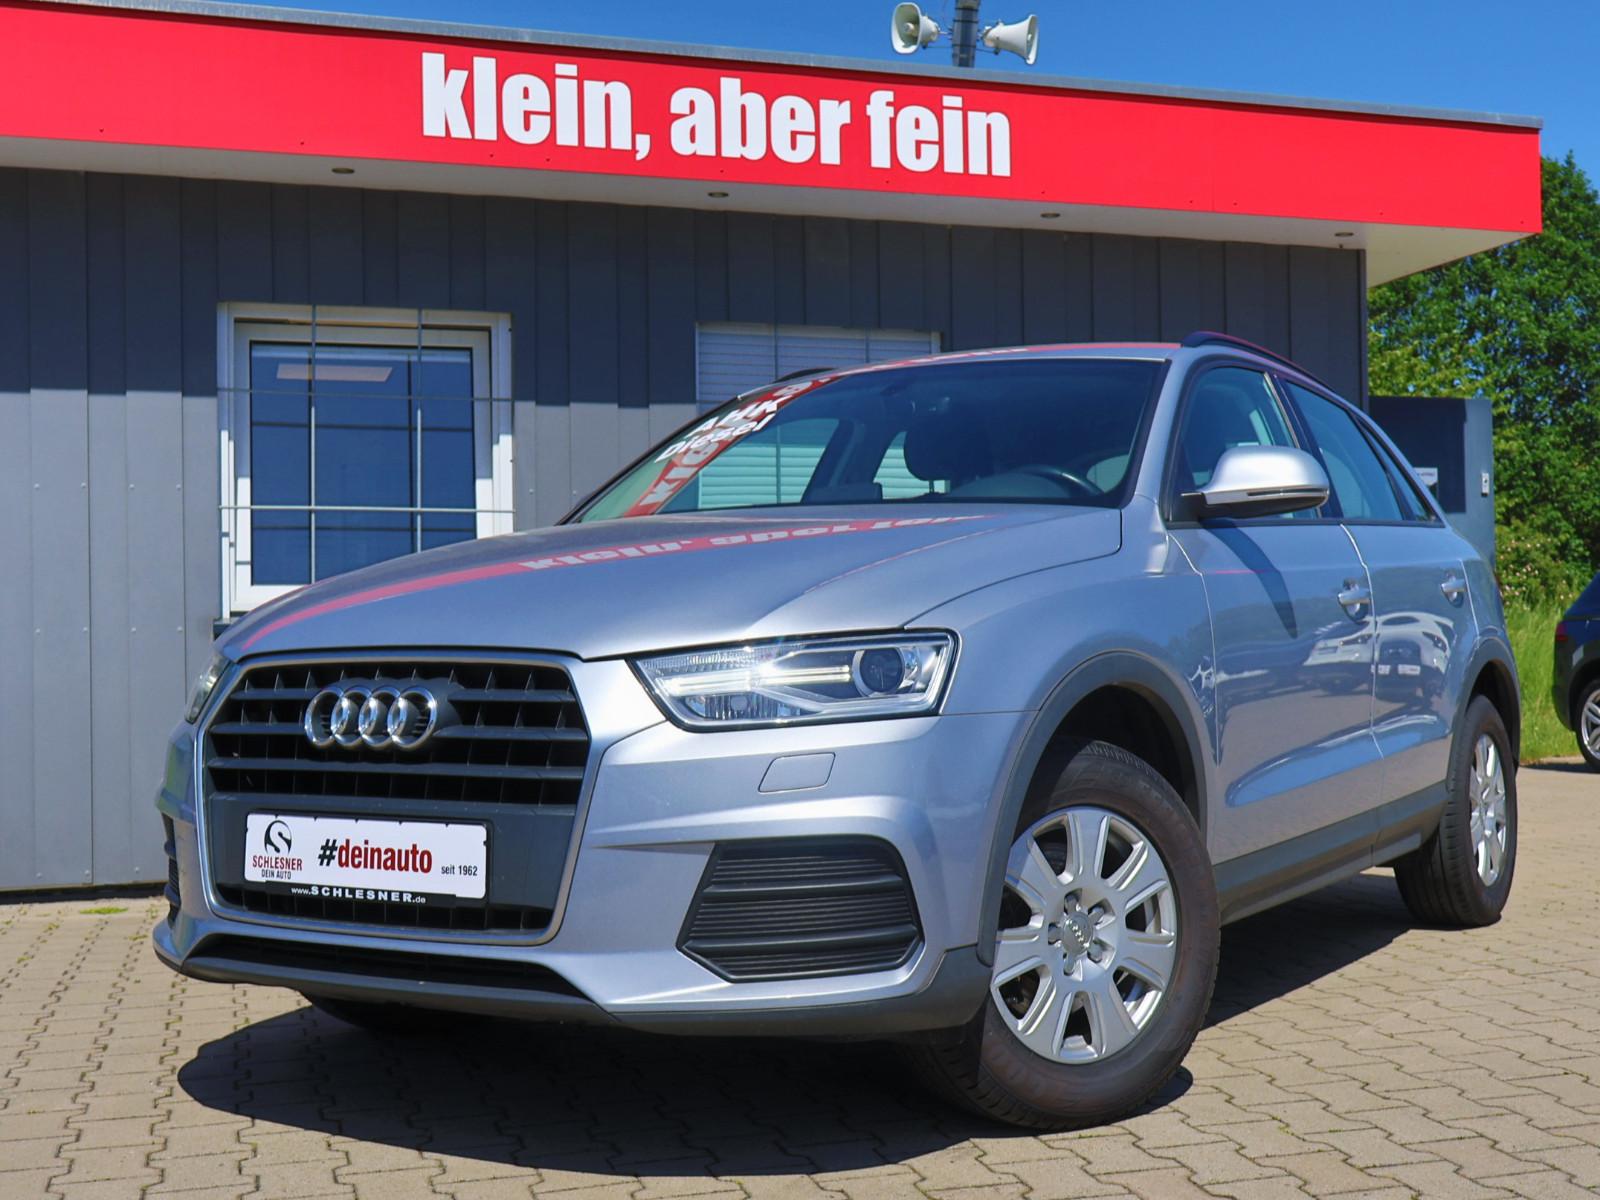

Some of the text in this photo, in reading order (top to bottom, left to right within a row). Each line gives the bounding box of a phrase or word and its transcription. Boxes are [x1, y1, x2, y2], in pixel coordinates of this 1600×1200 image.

[421, 52, 1011, 177] klein, aber fein
[654, 412, 776, 464] Diesel
[252, 854, 303, 872] SCHLESNER
[318, 838, 433, 874] #deinauto
[261, 868, 292, 880] DEIN AUTO
[440, 864, 478, 877] seit 1962
[291, 885, 426, 904] www.SCHLESNER.de
